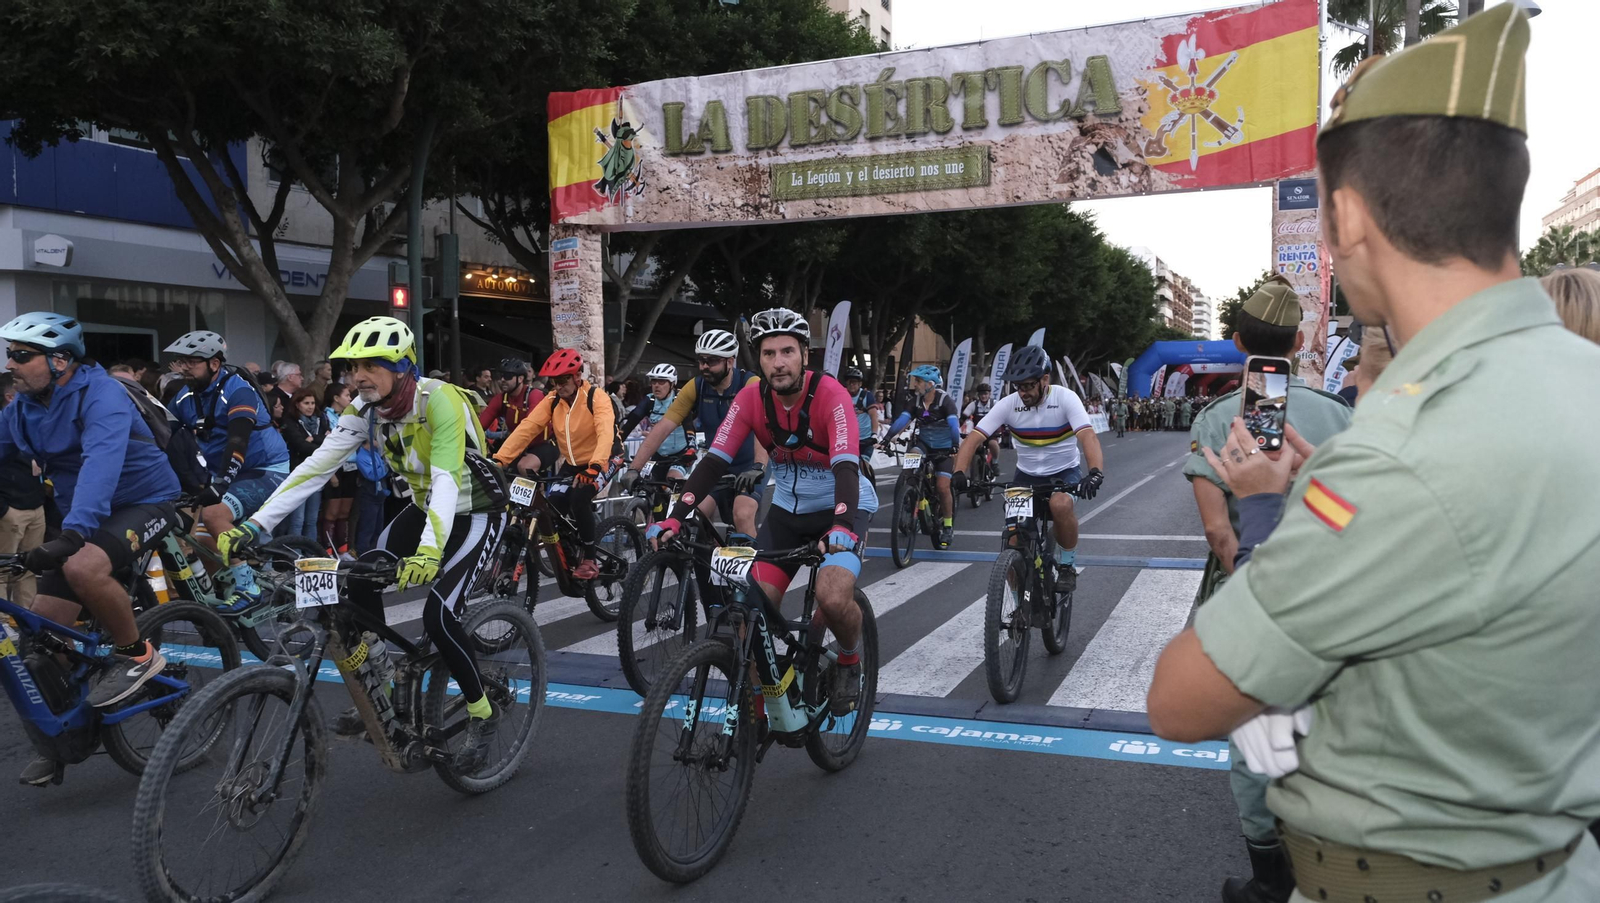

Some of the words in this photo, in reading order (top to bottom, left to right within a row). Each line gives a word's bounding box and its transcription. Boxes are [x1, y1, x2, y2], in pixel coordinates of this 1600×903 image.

[662, 99, 734, 155] LA
[746, 55, 1123, 151] DESÉRTICA
[791, 172, 803, 187] La
[807, 169, 841, 187] Legión
[846, 171, 853, 185] y
[858, 167, 868, 181] el
[872, 164, 915, 180] desierto
[920, 163, 939, 177] nos
[944, 161, 965, 175] une
[1279, 244, 1316, 252] GRUPO
[1279, 251, 1317, 261] RENTA
[213, 262, 328, 288] VIDENT
[1279, 262, 1317, 274] TODO
[556, 313, 577, 321] BBVA
[714, 401, 740, 447] TROTACUMES
[833, 403, 849, 452] TROTACUMES
[467, 452, 504, 496] SCOTT
[512, 485, 532, 499] 10162
[143, 517, 168, 543] ALOA
[464, 523, 496, 600] SCOTT
[714, 557, 748, 576] 10227
[300, 572, 334, 594] 10248
[723, 703, 740, 736] FOX
[911, 723, 1064, 747] cajamar
